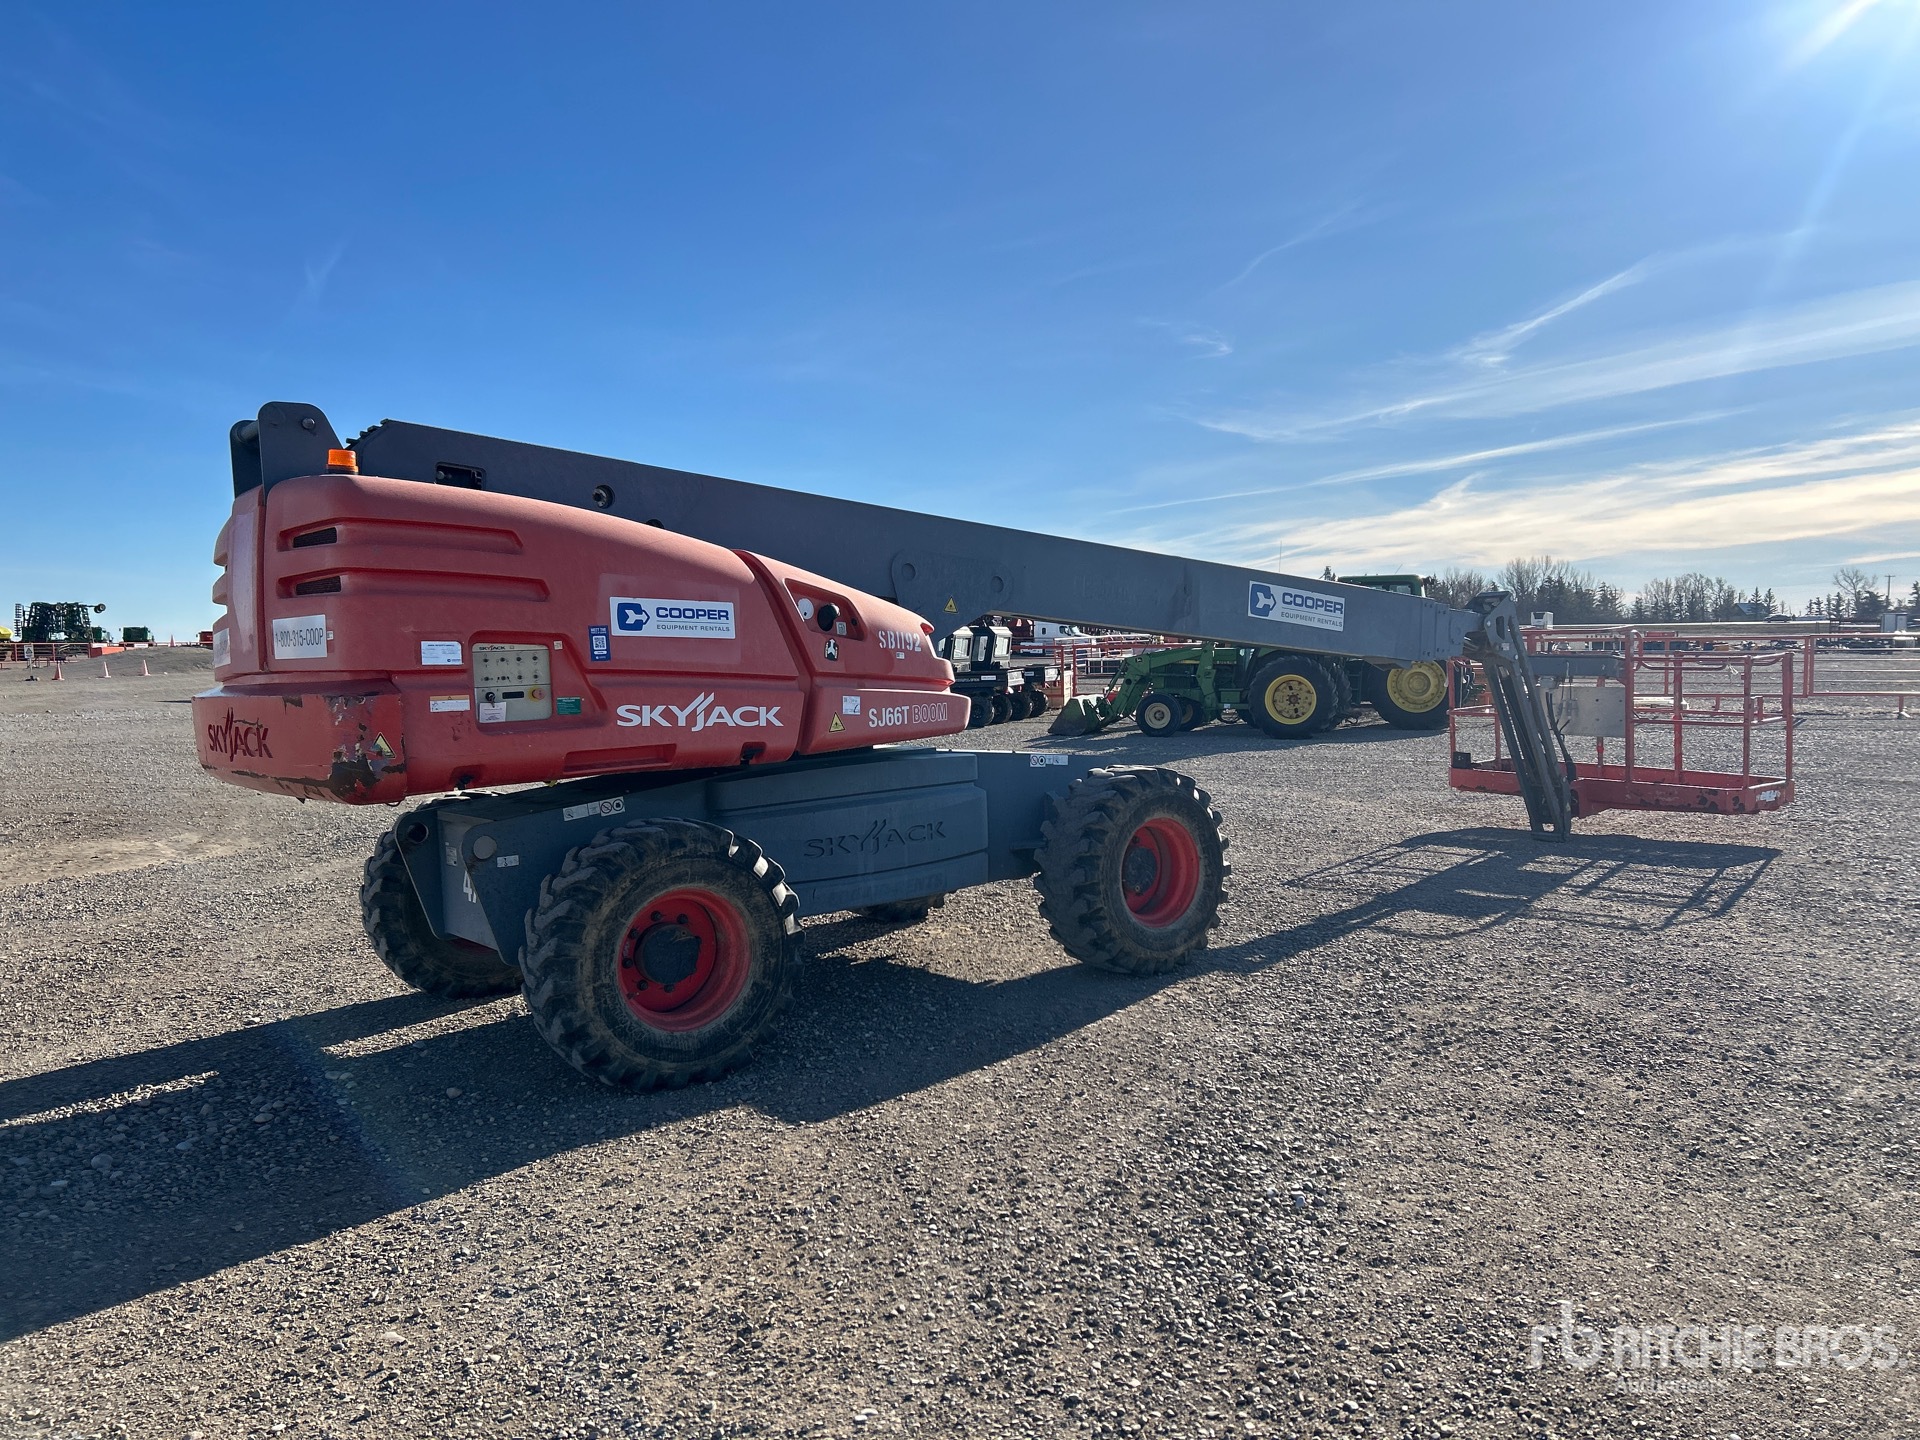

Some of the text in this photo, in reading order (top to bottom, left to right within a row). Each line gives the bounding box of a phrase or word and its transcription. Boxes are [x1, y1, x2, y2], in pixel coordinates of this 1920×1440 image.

[655, 606, 730, 620] COOPER
[1281, 592, 1343, 615] COOPER
[1280, 611, 1343, 628] EQUIPMENT RENTALS
[878, 630, 922, 652] SB1192
[616, 691, 785, 732] SKYJACK
[868, 702, 948, 728] SJ66T BOOM
[207, 707, 274, 763] SKYJACK
[803, 818, 946, 857] SKYJACK
